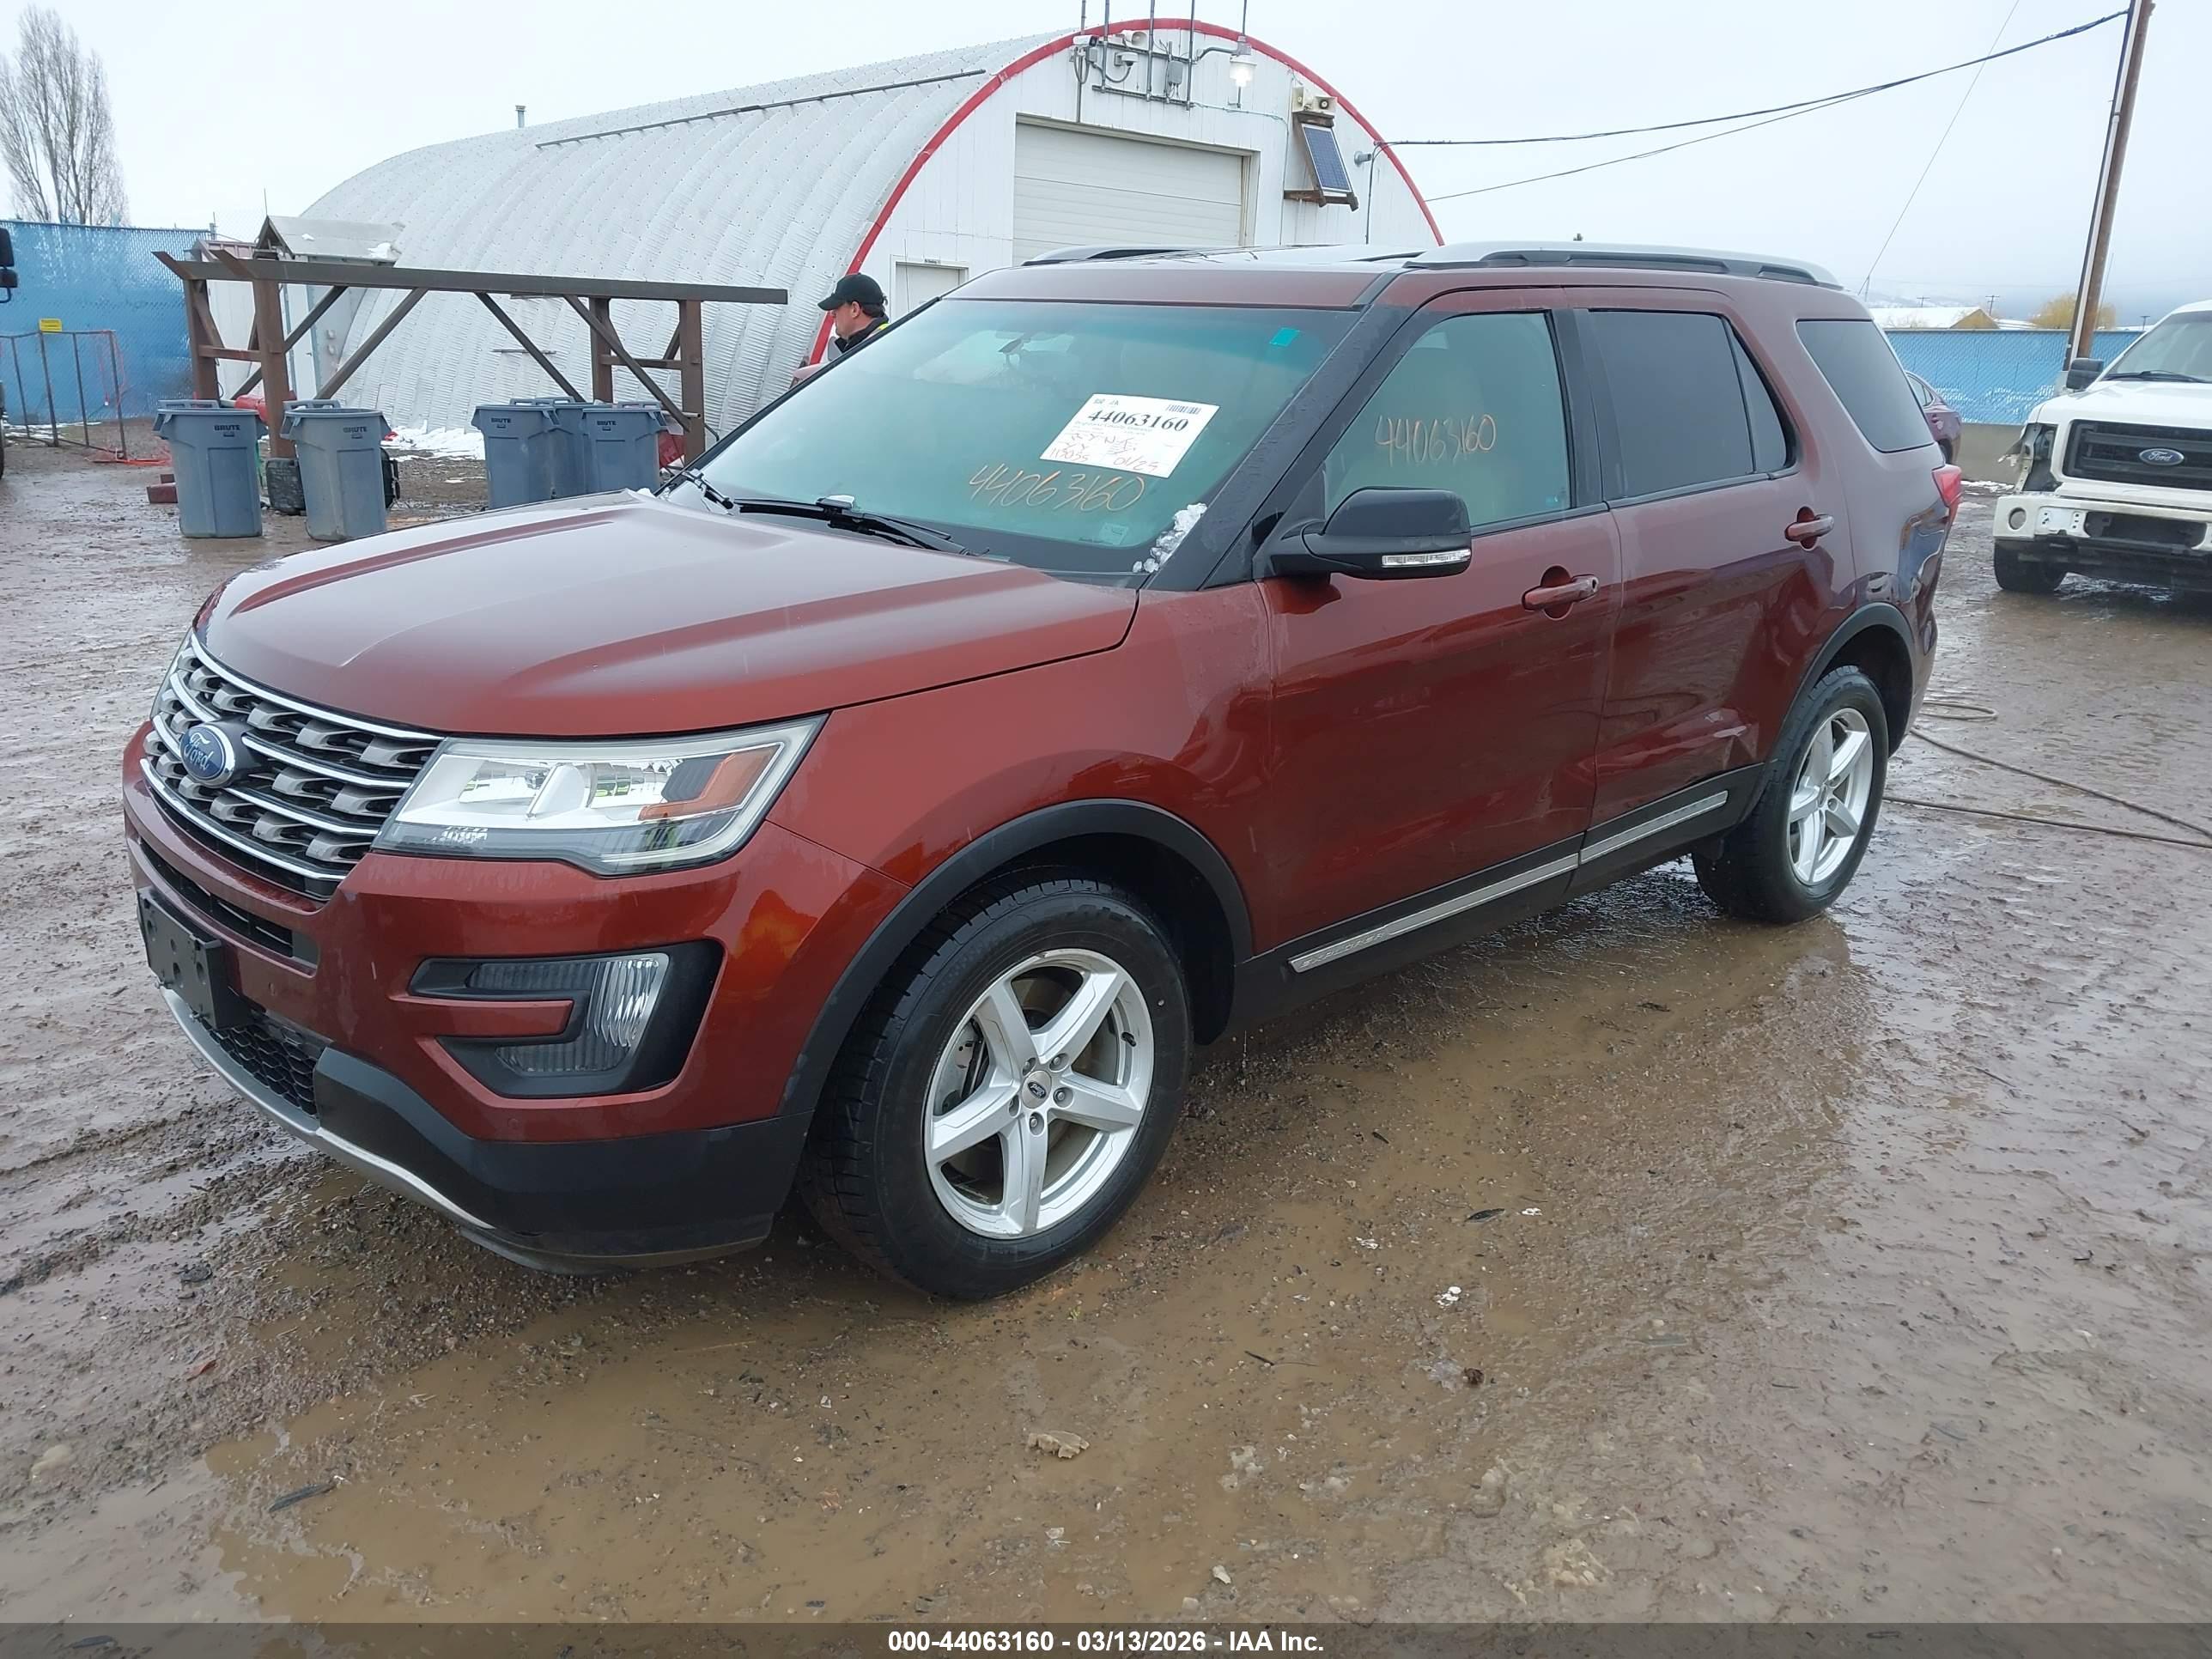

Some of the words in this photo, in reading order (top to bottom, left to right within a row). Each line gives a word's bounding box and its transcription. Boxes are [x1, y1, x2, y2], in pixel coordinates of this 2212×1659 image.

[1088, 409, 1189, 432] 44063160
[1375, 414, 1496, 467] 44063160
[2148, 451, 2173, 462] Ford
[969, 463, 1145, 512] 44063160
[183, 732, 214, 771] Ford
